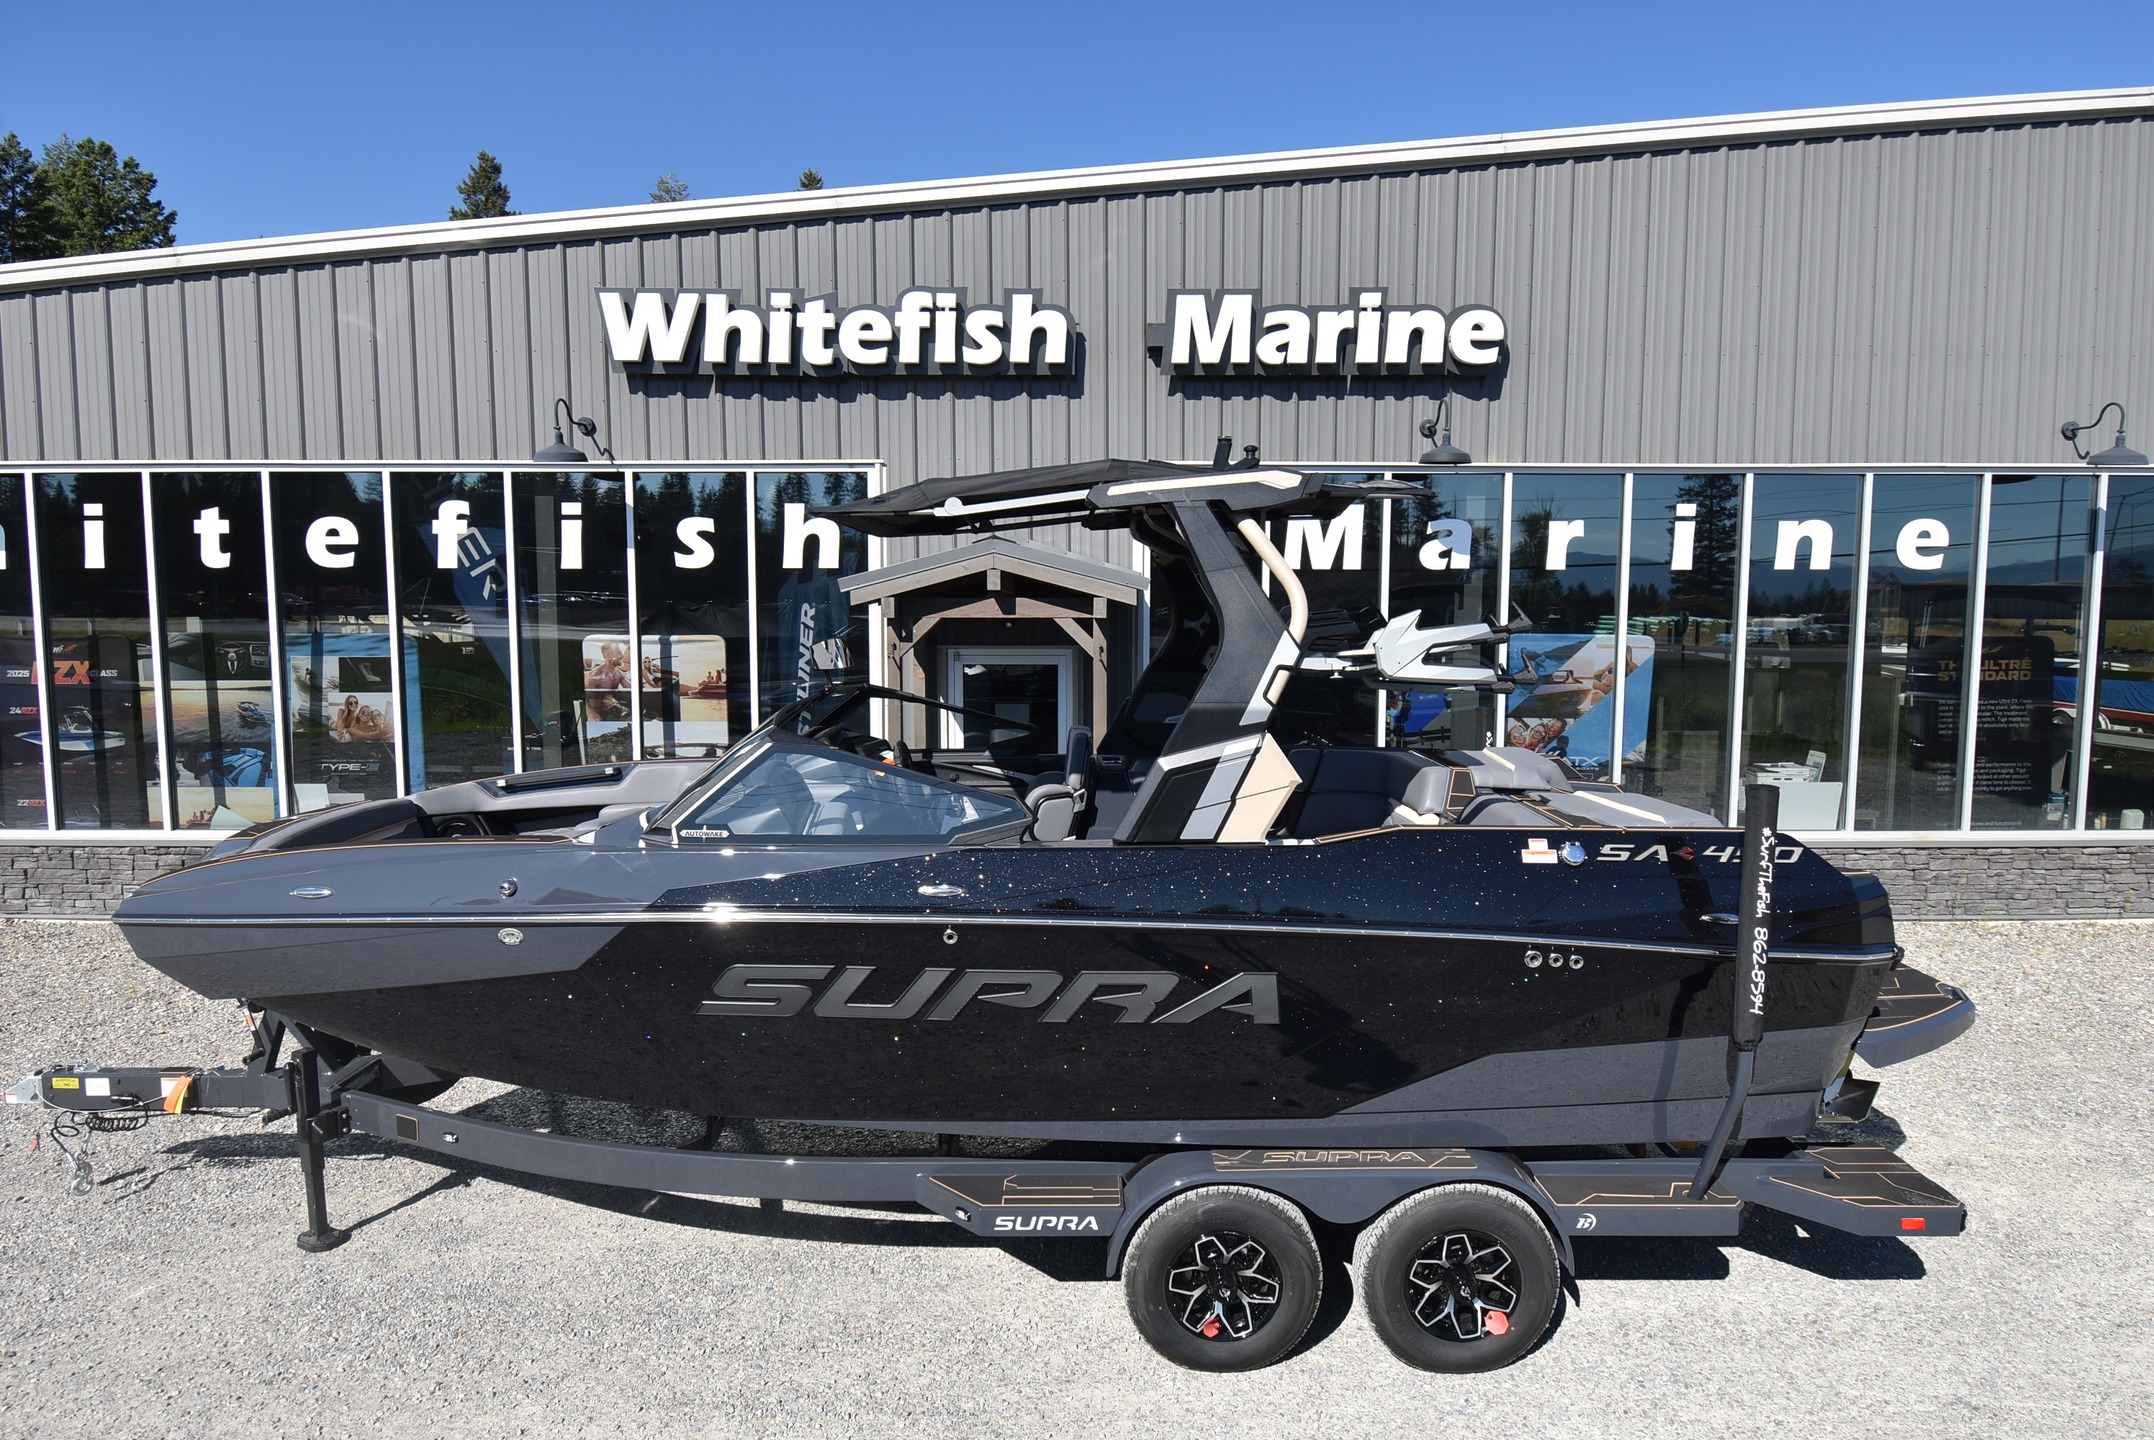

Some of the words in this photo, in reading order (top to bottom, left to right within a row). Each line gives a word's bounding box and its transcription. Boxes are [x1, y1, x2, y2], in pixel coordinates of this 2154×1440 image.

[599, 290, 1068, 366] Whitefish
[1170, 291, 1505, 365] Marine
[6, 670, 30, 678] 2025
[1596, 844, 1668, 862] SA
[1702, 845, 1804, 863] 40
[1749, 927, 1768, 1016] 862-8594
[694, 963, 1281, 1025] SUPRA
[1262, 1150, 1426, 1164] SUPRA
[993, 1215, 1099, 1231] SUPRA
